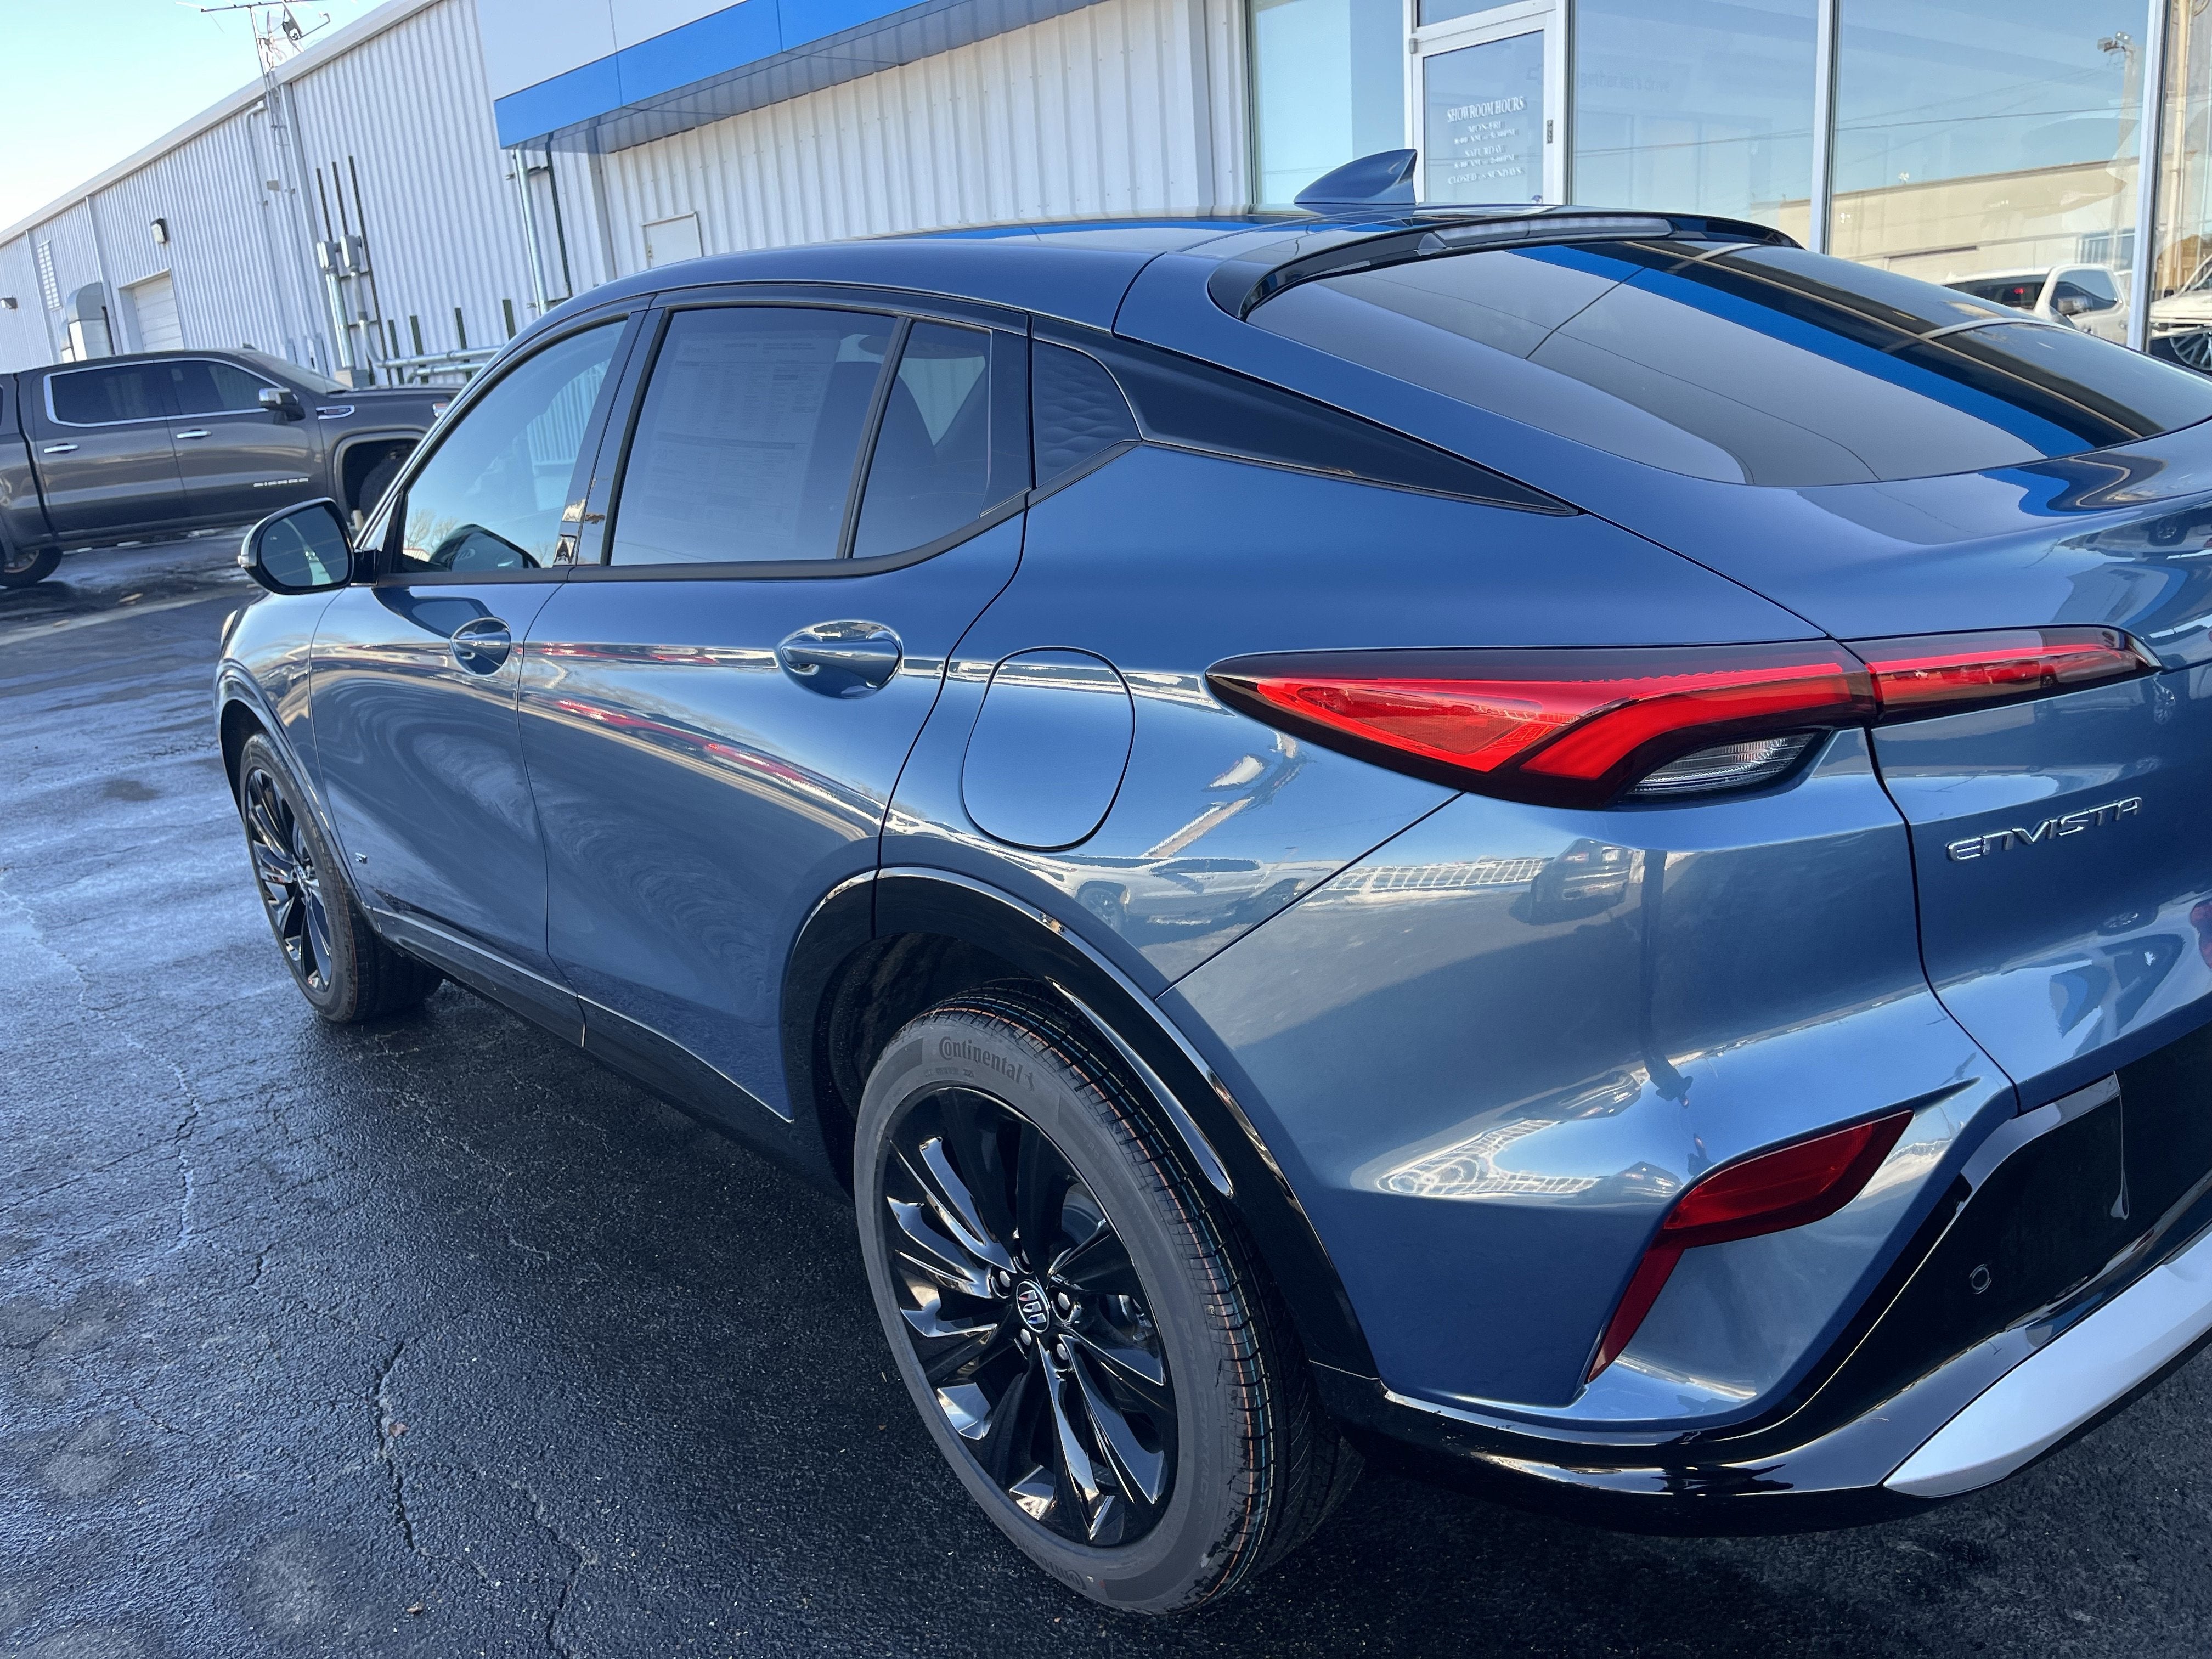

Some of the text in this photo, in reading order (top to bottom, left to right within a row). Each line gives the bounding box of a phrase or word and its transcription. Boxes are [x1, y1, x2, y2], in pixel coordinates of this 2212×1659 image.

[1447, 96, 1525, 122] SHOWROOM HOURS
[1945, 796, 2142, 861] ENVISTA
[939, 1036, 1023, 1085] Continental
